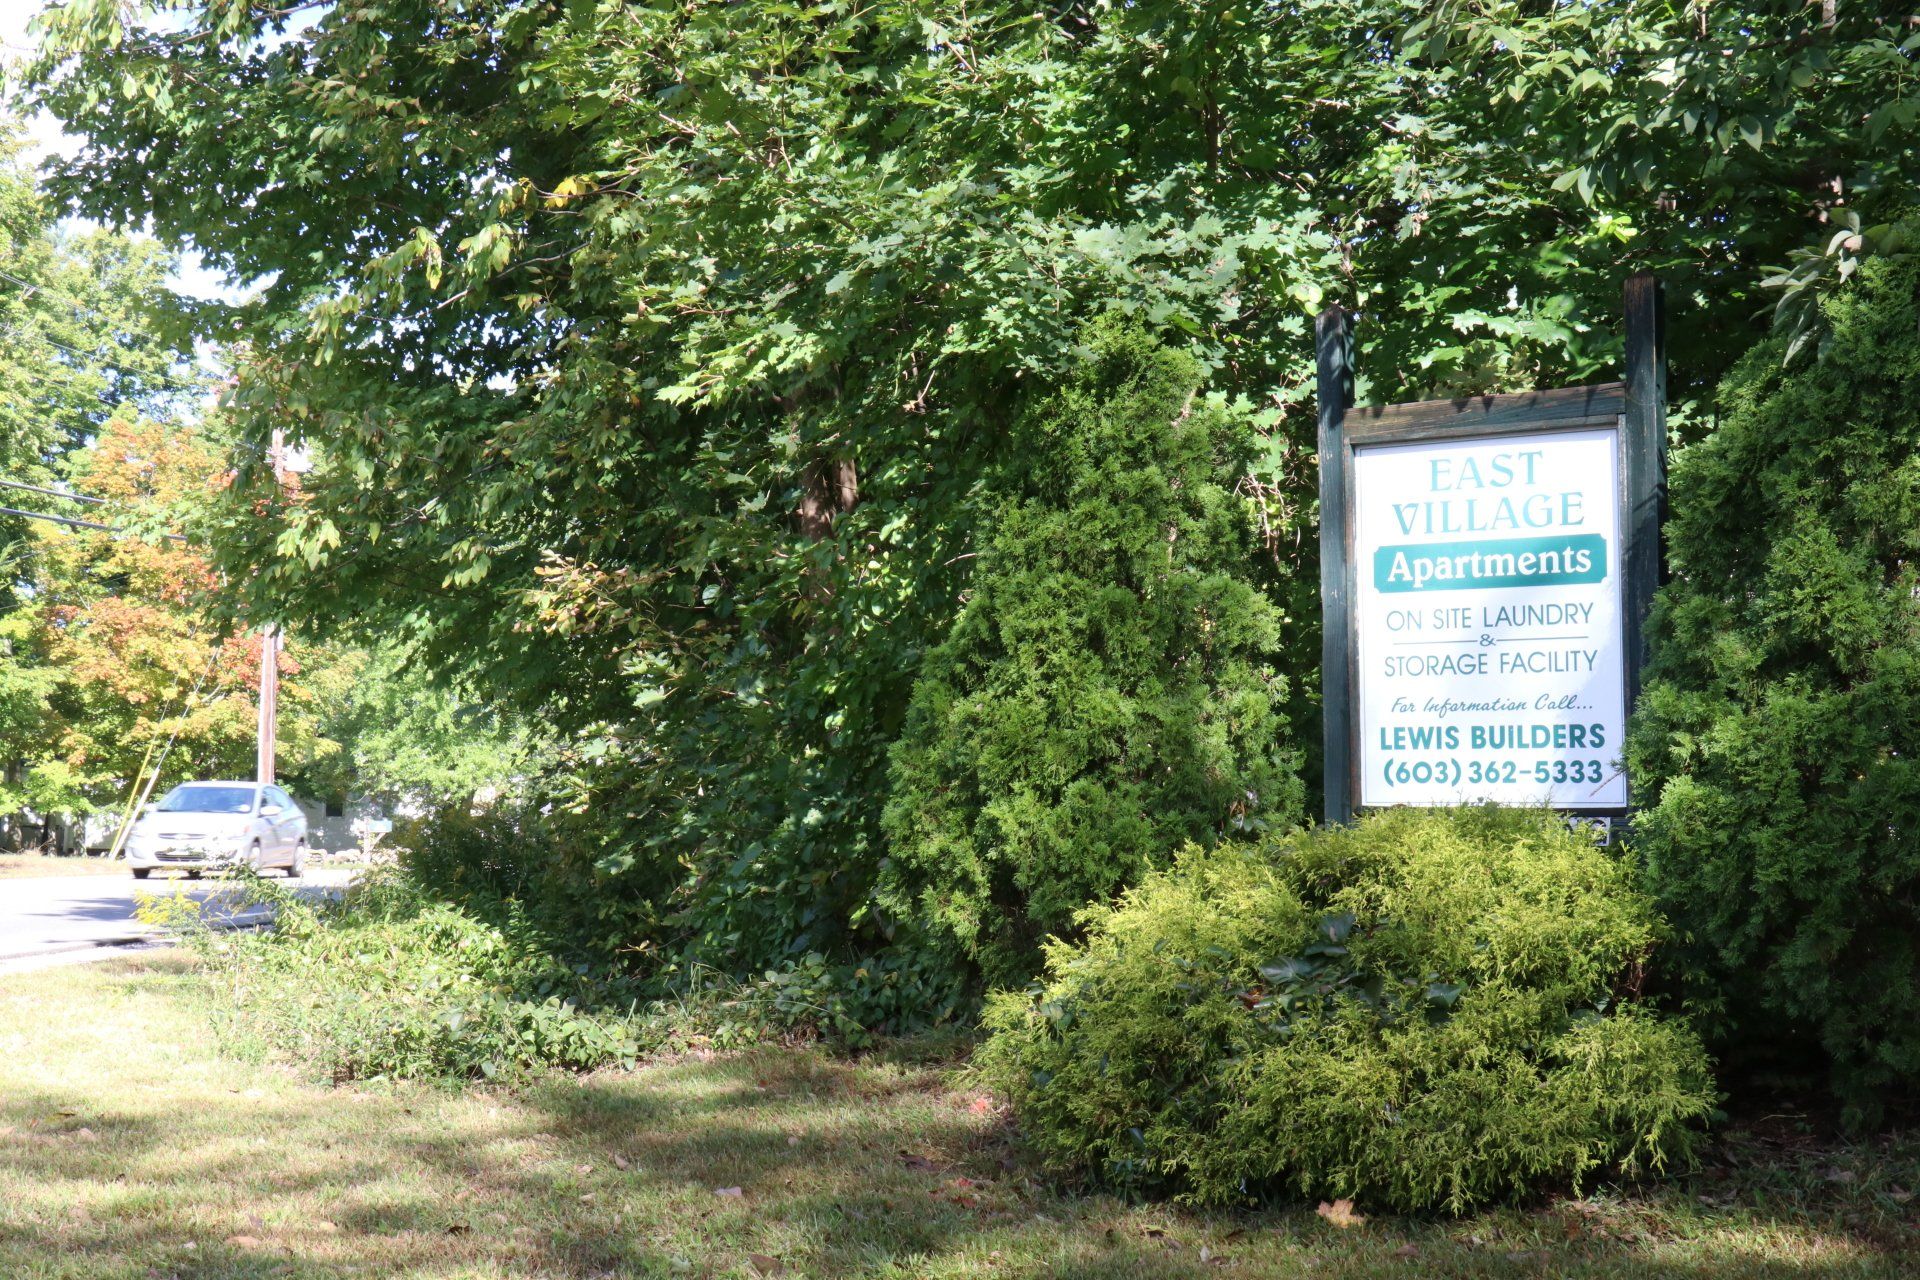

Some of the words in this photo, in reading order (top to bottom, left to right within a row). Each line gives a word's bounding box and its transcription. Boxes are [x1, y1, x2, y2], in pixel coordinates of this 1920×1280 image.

[1430, 450, 1543, 491] EAST
[1392, 491, 1585, 536] VILLAGE
[1387, 546, 1592, 588] Apartments
[1386, 610, 1422, 631] ON
[1433, 607, 1472, 629] SITE
[1483, 602, 1594, 628] LAUNDRY
[1480, 633, 1496, 647] &
[1384, 653, 1488, 677] STORAGE
[1500, 649, 1598, 673] FACILITY
[1391, 696, 1416, 713] For
[1423, 696, 1527, 718] Information
[1380, 725, 1459, 750] LEWIS
[1471, 723, 1606, 749] BUILDERS
[1384, 757, 1461, 787] (603)
[1468, 760, 1602, 784] 362-5333
